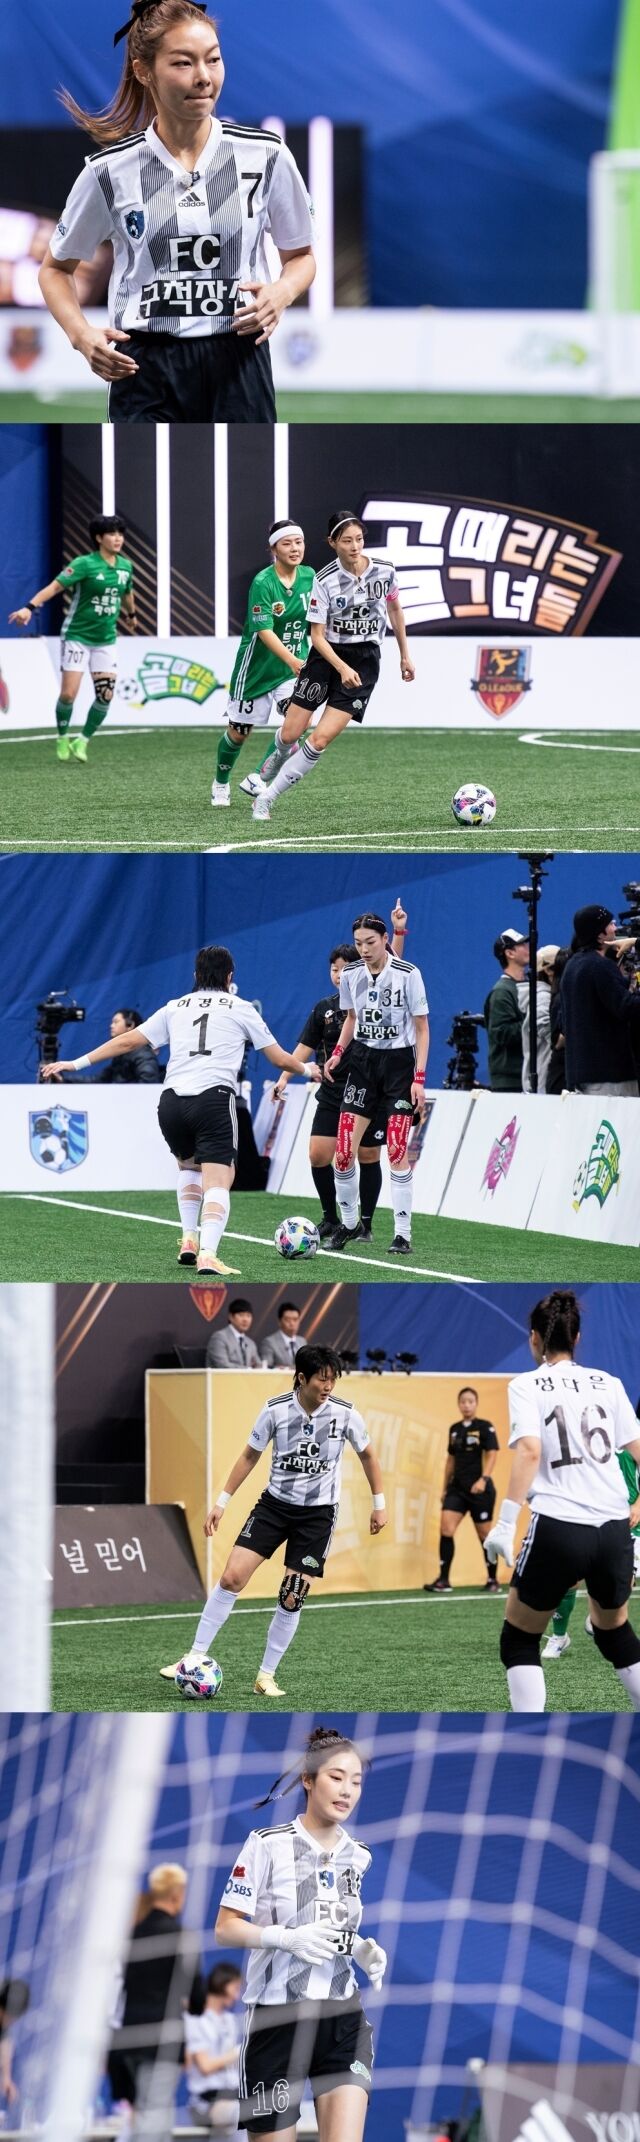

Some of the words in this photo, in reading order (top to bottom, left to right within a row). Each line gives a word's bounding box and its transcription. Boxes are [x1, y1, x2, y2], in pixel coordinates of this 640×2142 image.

[241, 172, 262, 218] 7
[169, 234, 220, 272] FC
[362, 500, 600, 630] 골때리는
[448, 566, 582, 633] 그녀들
[350, 606, 370, 619] FC
[285, 620, 302, 631] FC
[333, 619, 379, 635] 구척장신
[67, 650, 84, 664] 707
[239, 699, 254, 715] 13
[382, 988, 404, 1008] 31
[363, 1008, 383, 1024] FC
[189, 1013, 212, 1057] 1
[357, 1024, 399, 1039] 척장신
[344, 1084, 367, 1108] 31
[328, 1418, 338, 1439] 1
[544, 1404, 612, 1470] 16
[297, 1441, 320, 1458] FC
[241, 1516, 255, 1538] 1
[59, 1539, 89, 1573] 널
[94, 1537, 147, 1572] 믿어
[233, 1883, 253, 1897] SBS
[315, 1901, 348, 1926] FC
[253, 2079, 290, 2116] 16
